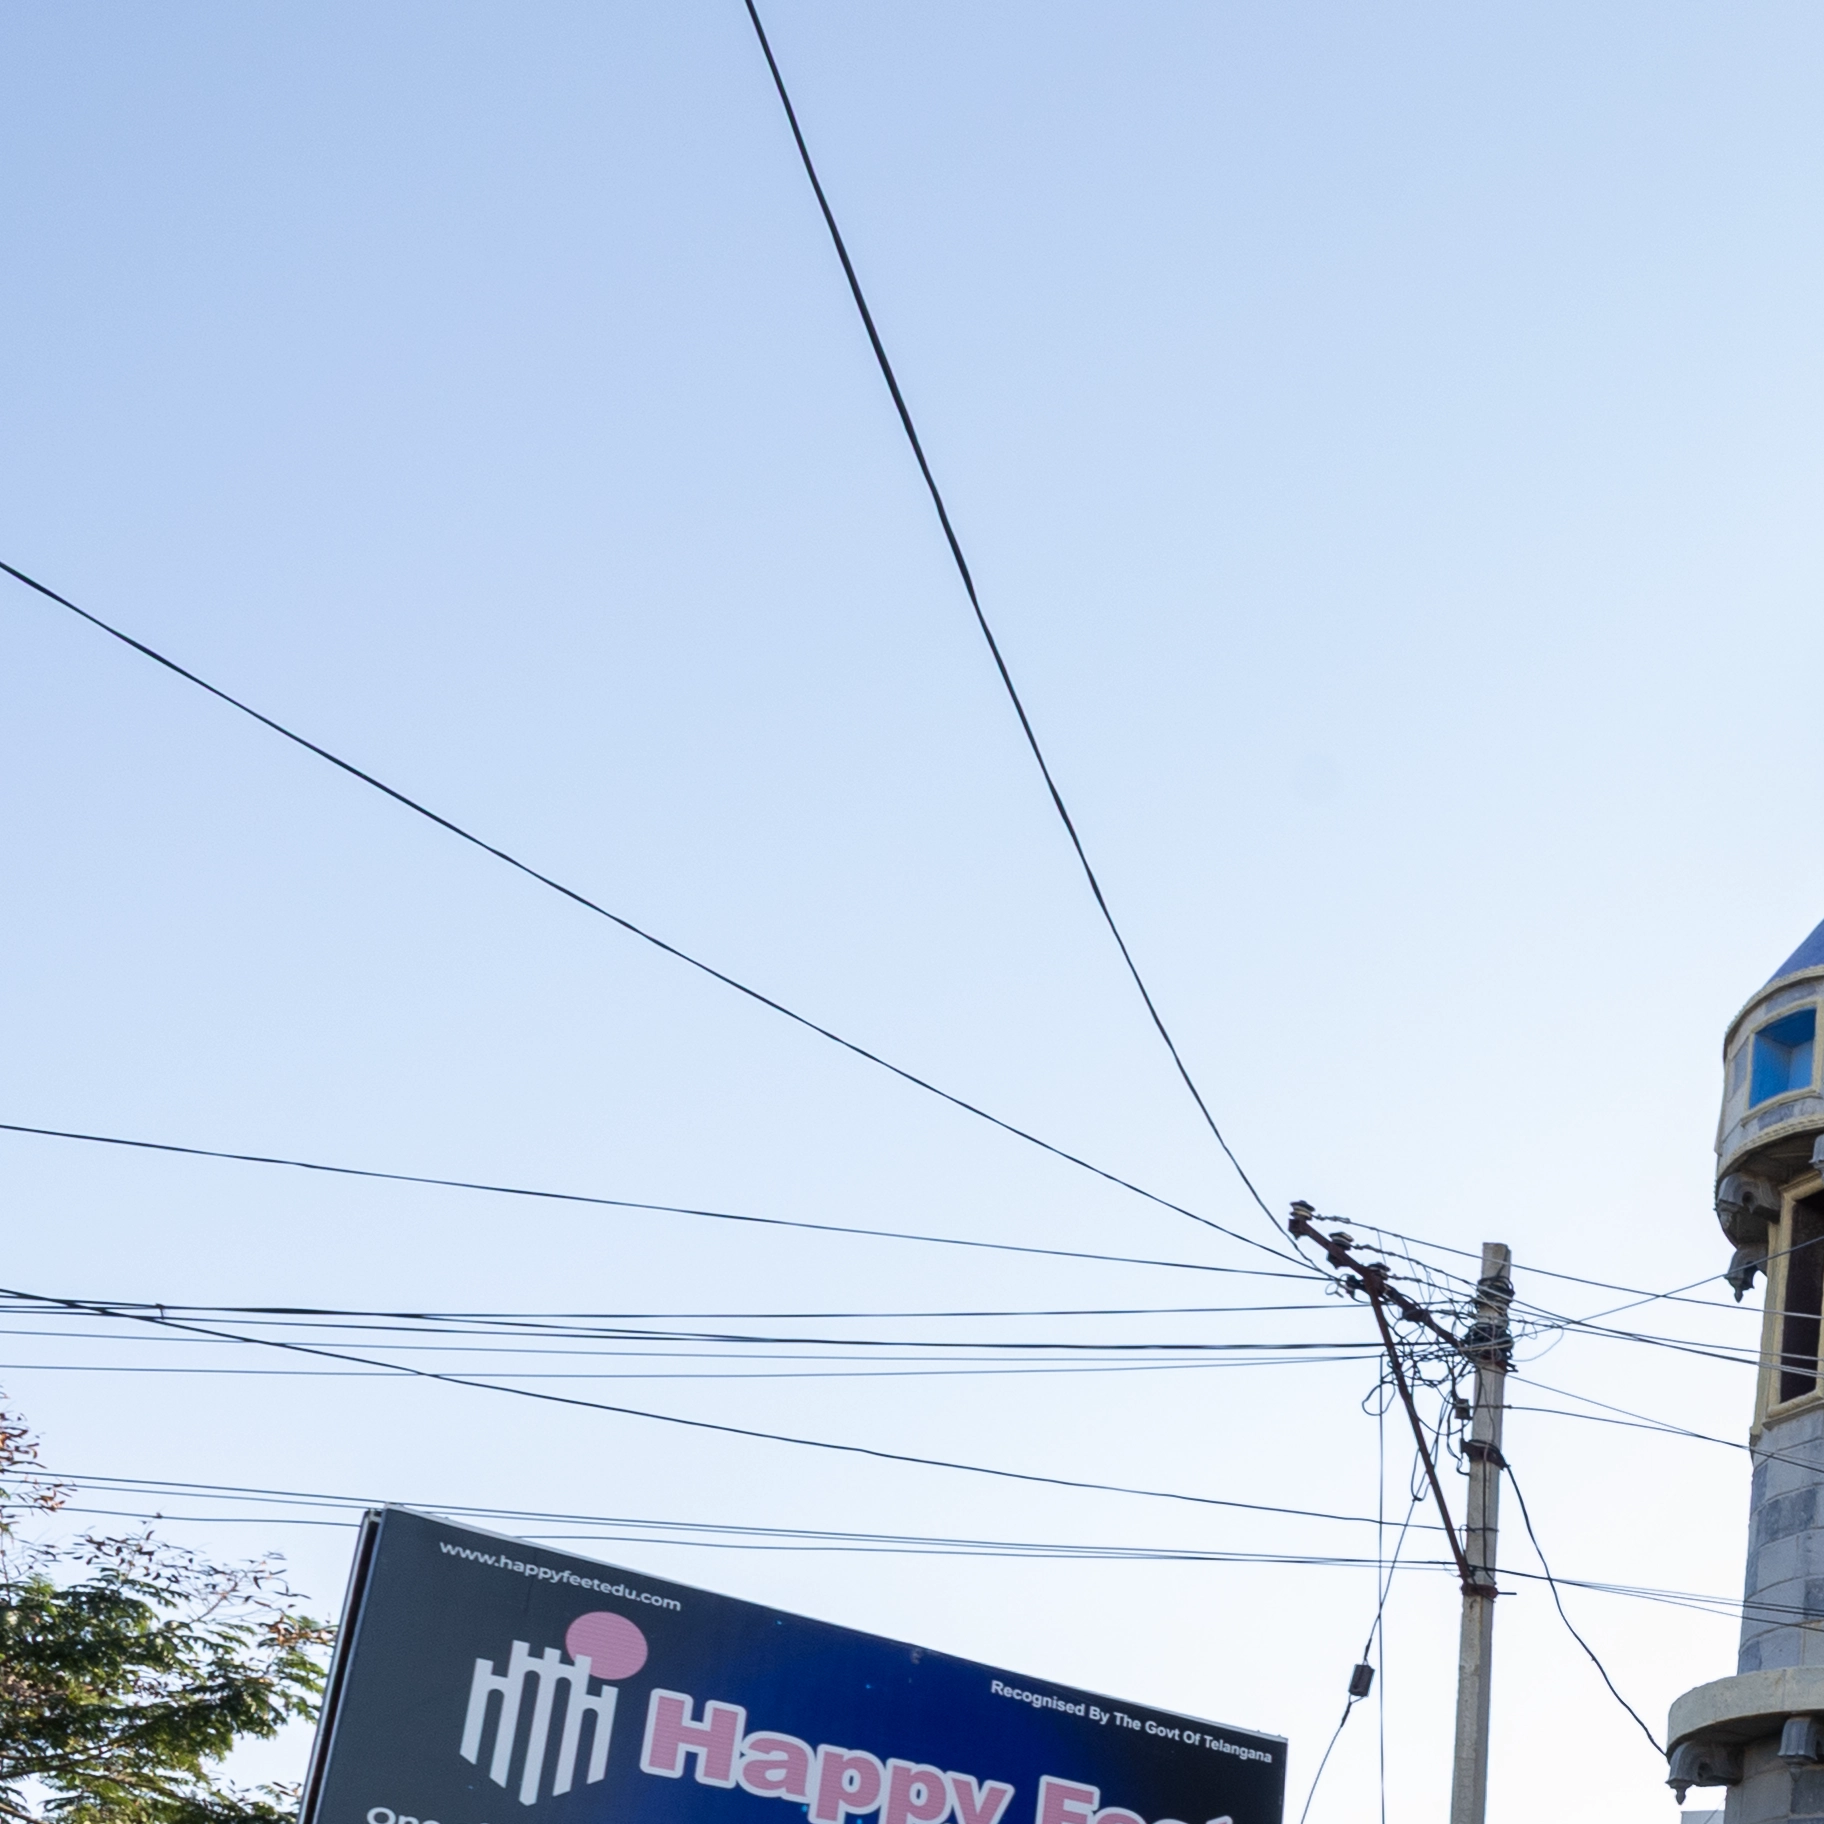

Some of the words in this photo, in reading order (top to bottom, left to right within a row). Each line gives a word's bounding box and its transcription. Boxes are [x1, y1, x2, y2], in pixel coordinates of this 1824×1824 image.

[440, 1542, 682, 1611] www.happyfeetedu.com
[991, 1680, 1085, 1716] Recognised
[1089, 1706, 1110, 1726] By
[1114, 1712, 1142, 1731] The
[1145, 1720, 1180, 1741] Govt
[1183, 1730, 1202, 1746] Of
[1204, 1735, 1272, 1763] Telangana
